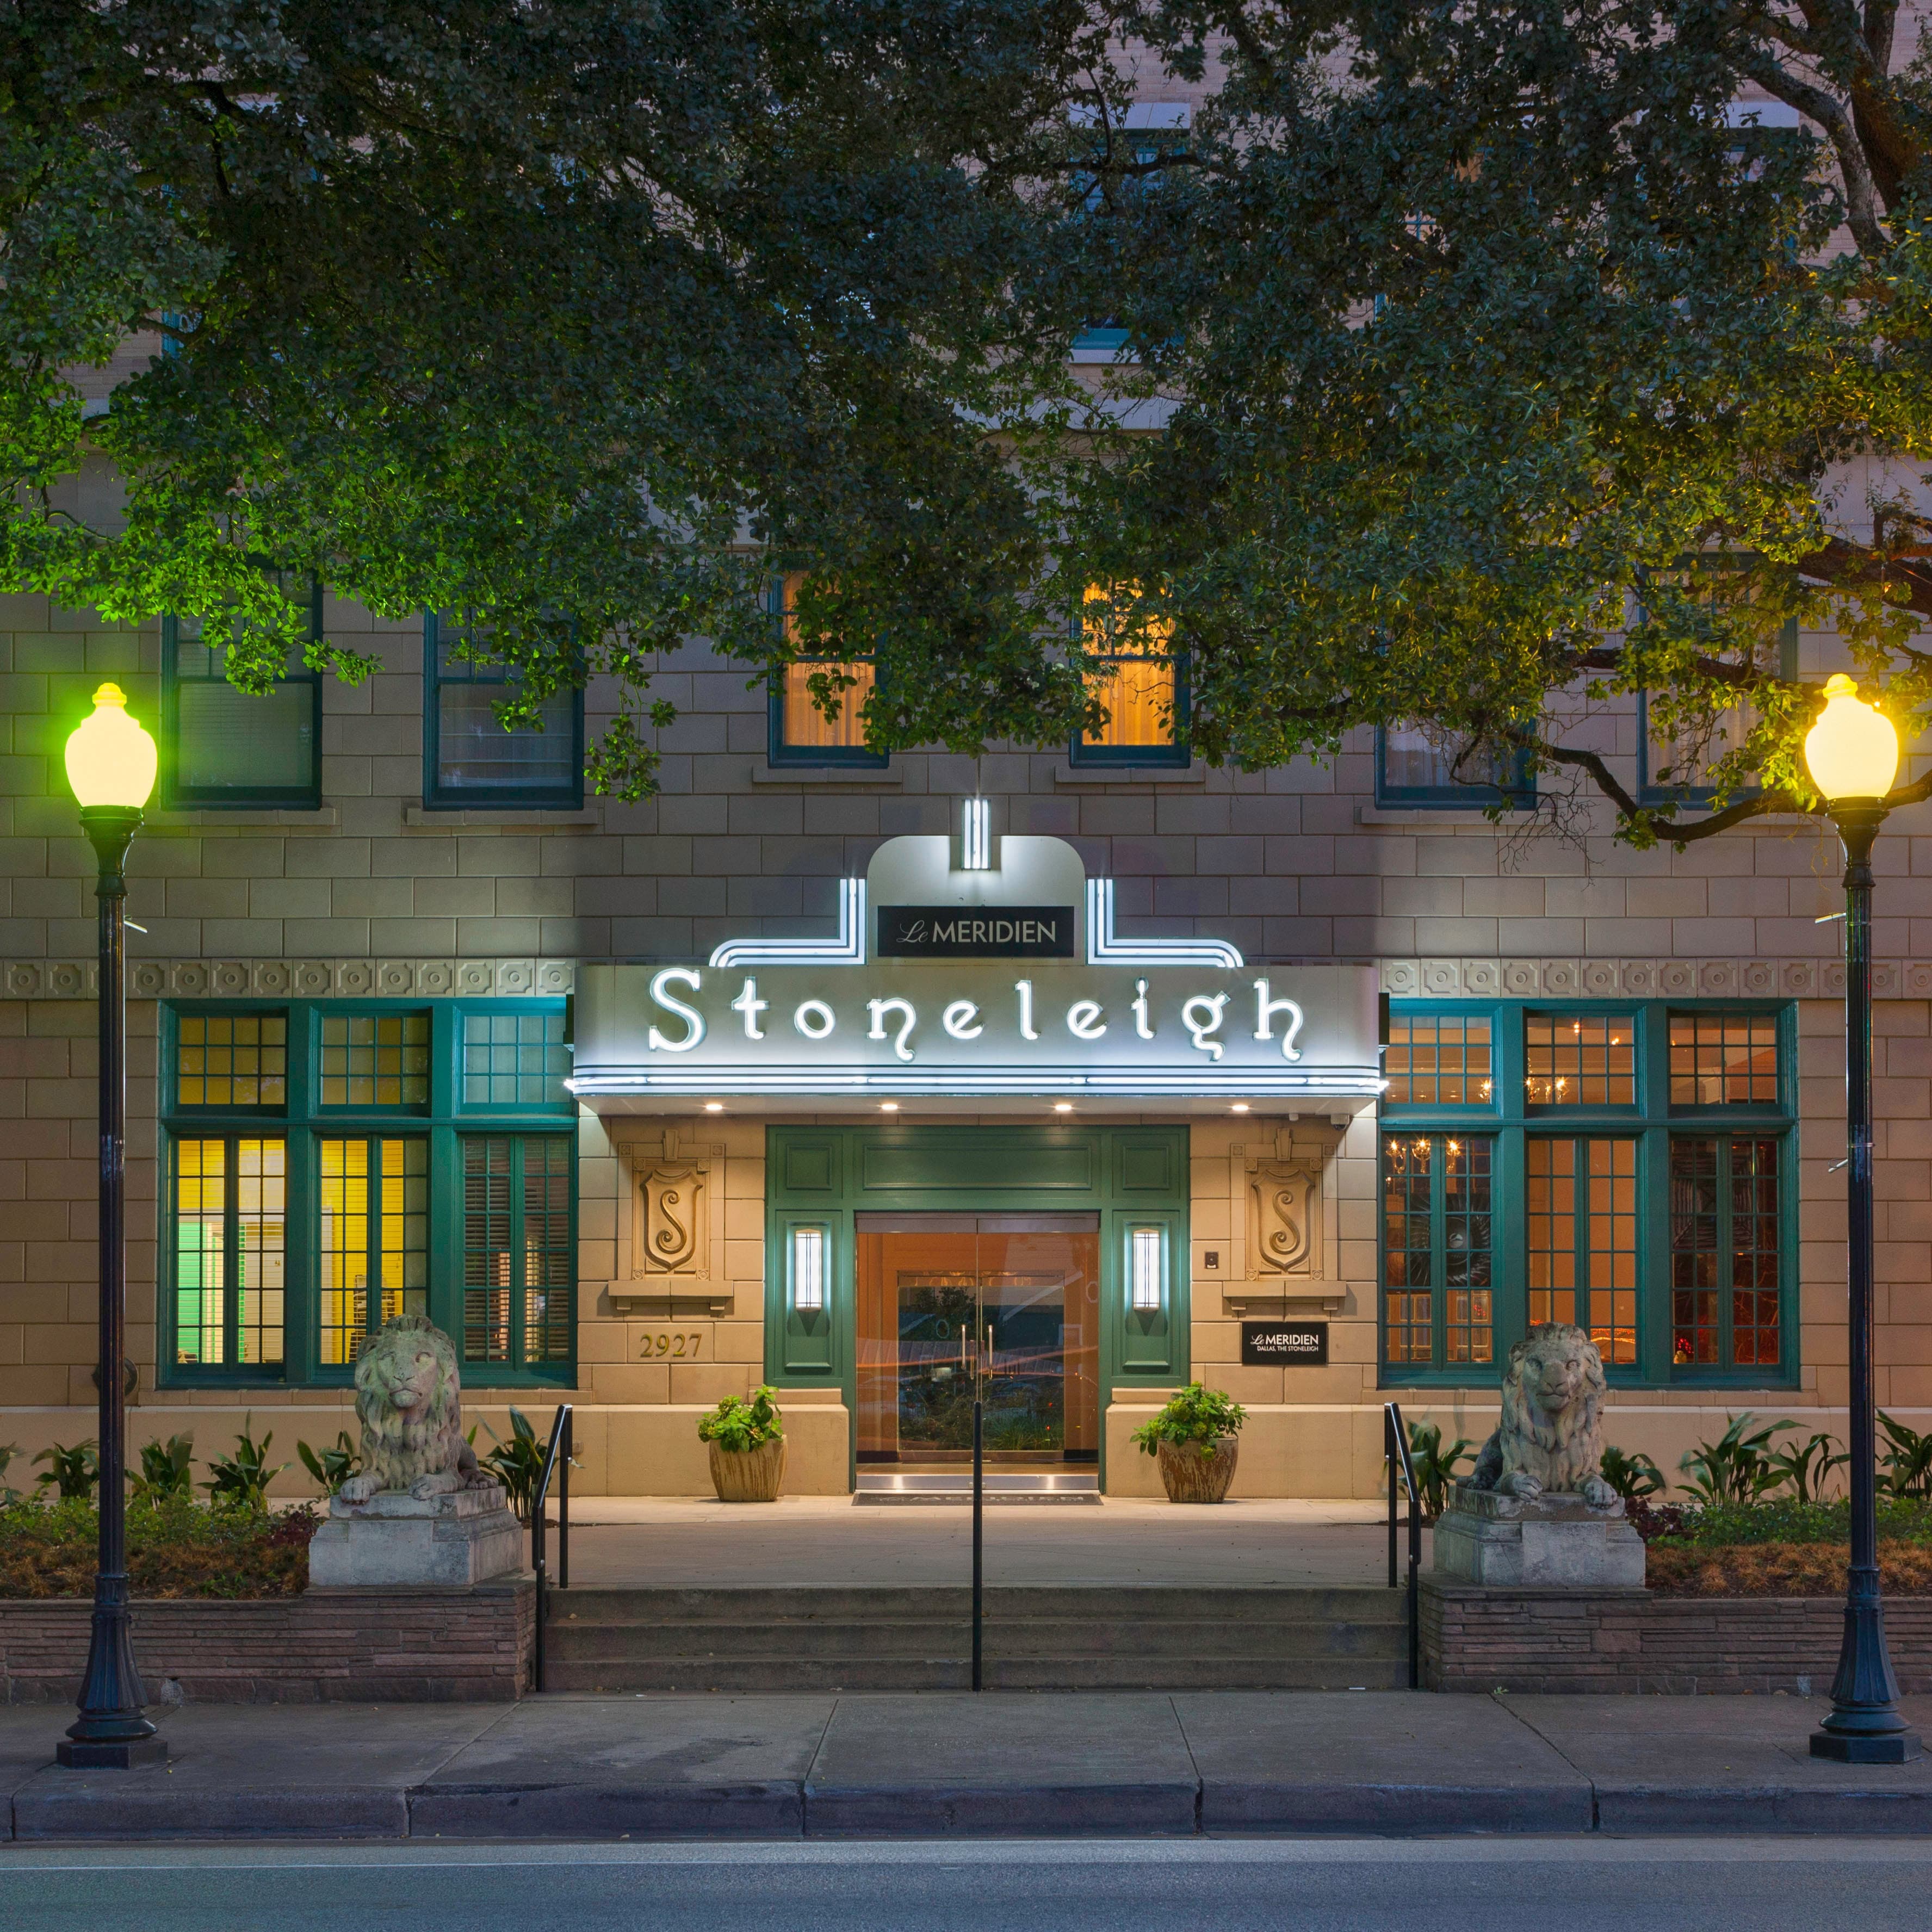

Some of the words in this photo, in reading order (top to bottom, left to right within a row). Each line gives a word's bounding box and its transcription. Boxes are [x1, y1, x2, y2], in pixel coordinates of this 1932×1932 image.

[897, 920, 928, 943] Le
[932, 920, 1056, 943] MERIDIEN
[649, 967, 1304, 1063] Stoneleigh
[640, 1334, 702, 1358] 2927
[1250, 1334, 1265, 1345] Le
[1265, 1334, 1318, 1345] MERIDIEN
